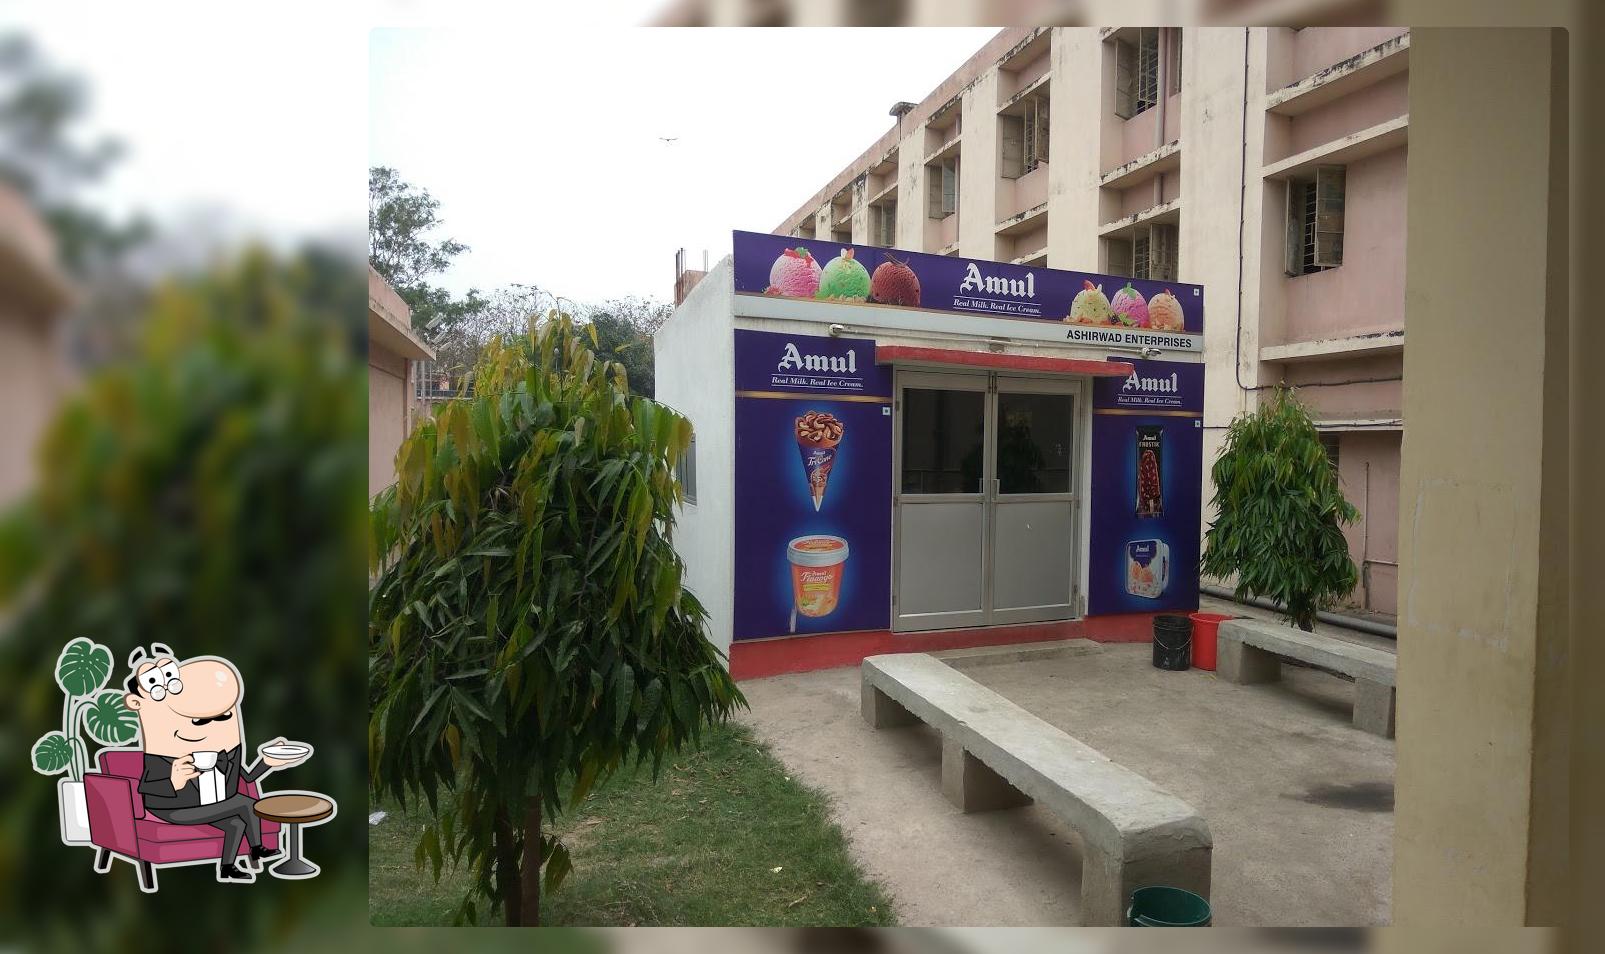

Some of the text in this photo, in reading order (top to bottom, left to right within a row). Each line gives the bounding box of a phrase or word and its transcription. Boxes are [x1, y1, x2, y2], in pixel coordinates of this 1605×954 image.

[959, 262, 1036, 298] Amul
[953, 299, 1042, 314] Real Milk. Real Ice Cream.
[1066, 329, 1192, 348] ASHIRWAD ENTERPRISES
[777, 342, 857, 374] Amul
[771, 376, 864, 388] Real Milk. Real Ice Cream.
[1122, 370, 1178, 393] Amul
